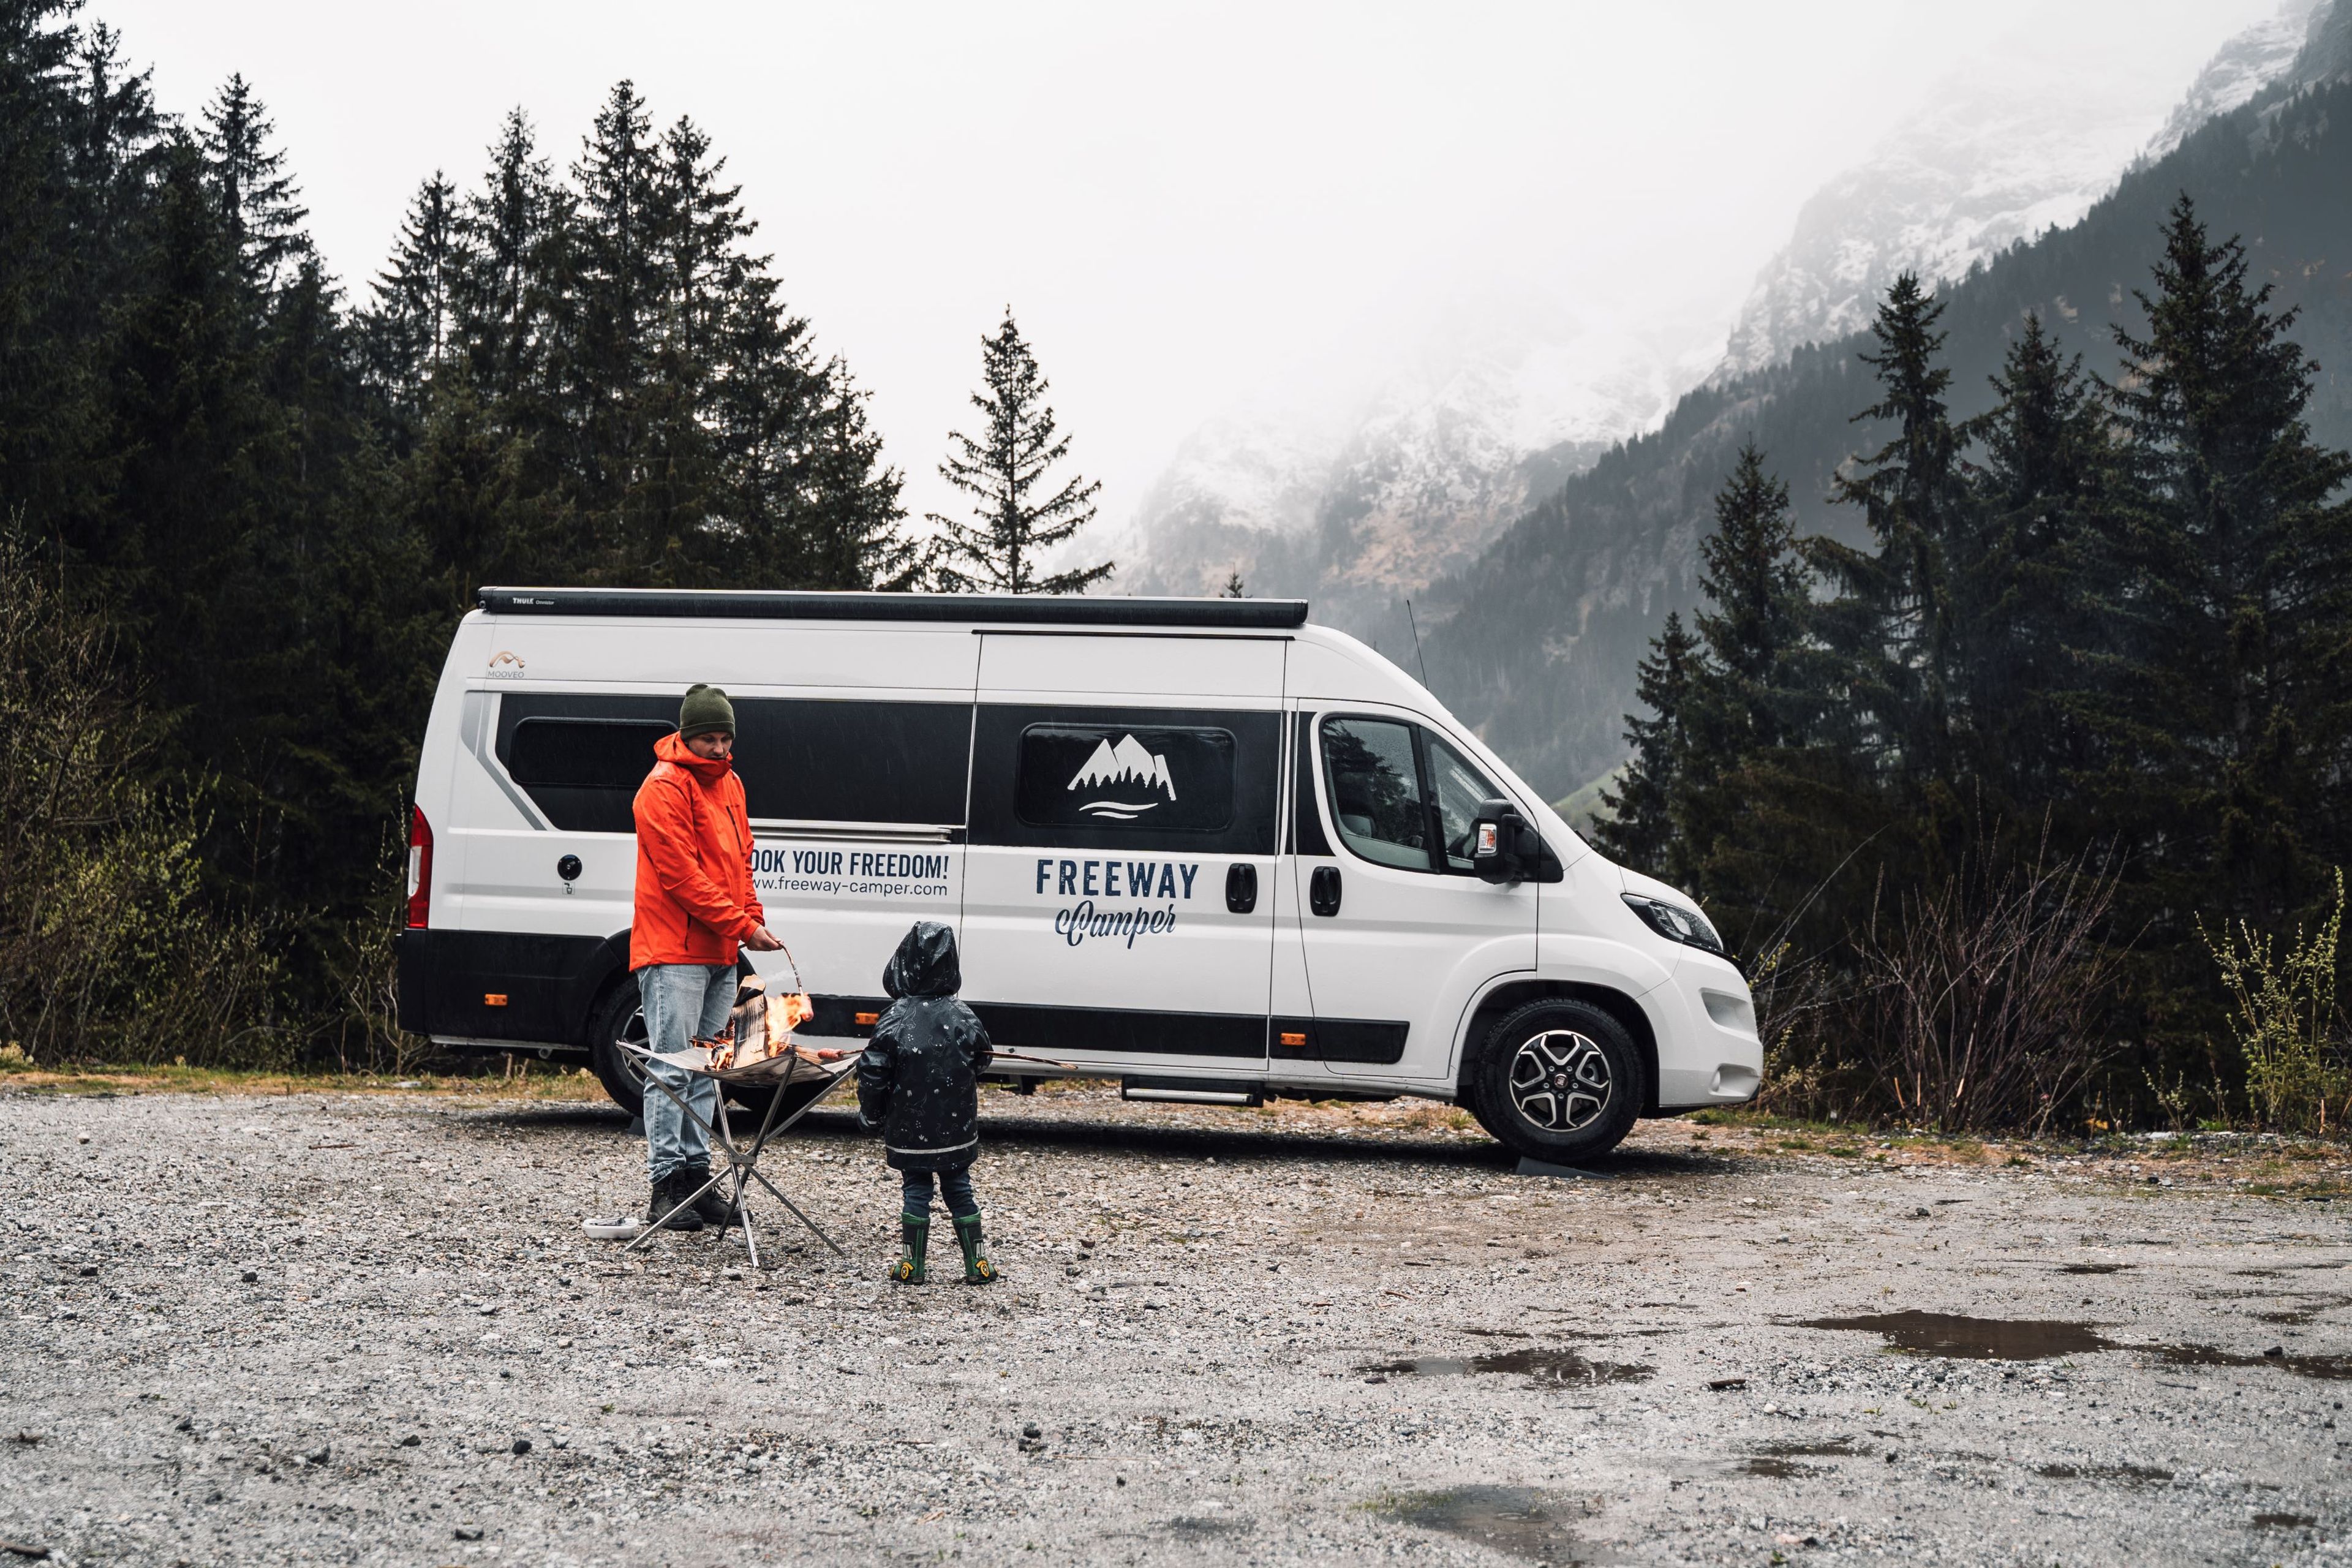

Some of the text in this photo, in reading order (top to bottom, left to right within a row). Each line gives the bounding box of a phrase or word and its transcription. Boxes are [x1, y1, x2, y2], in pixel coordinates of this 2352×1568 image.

[750, 849, 949, 880] OOK YOUR FREEDOM!
[1036, 859, 1199, 899] FREEWAY
[752, 876, 948, 897] ww.freeway-camper.com
[1055, 900, 1177, 950] Camper
